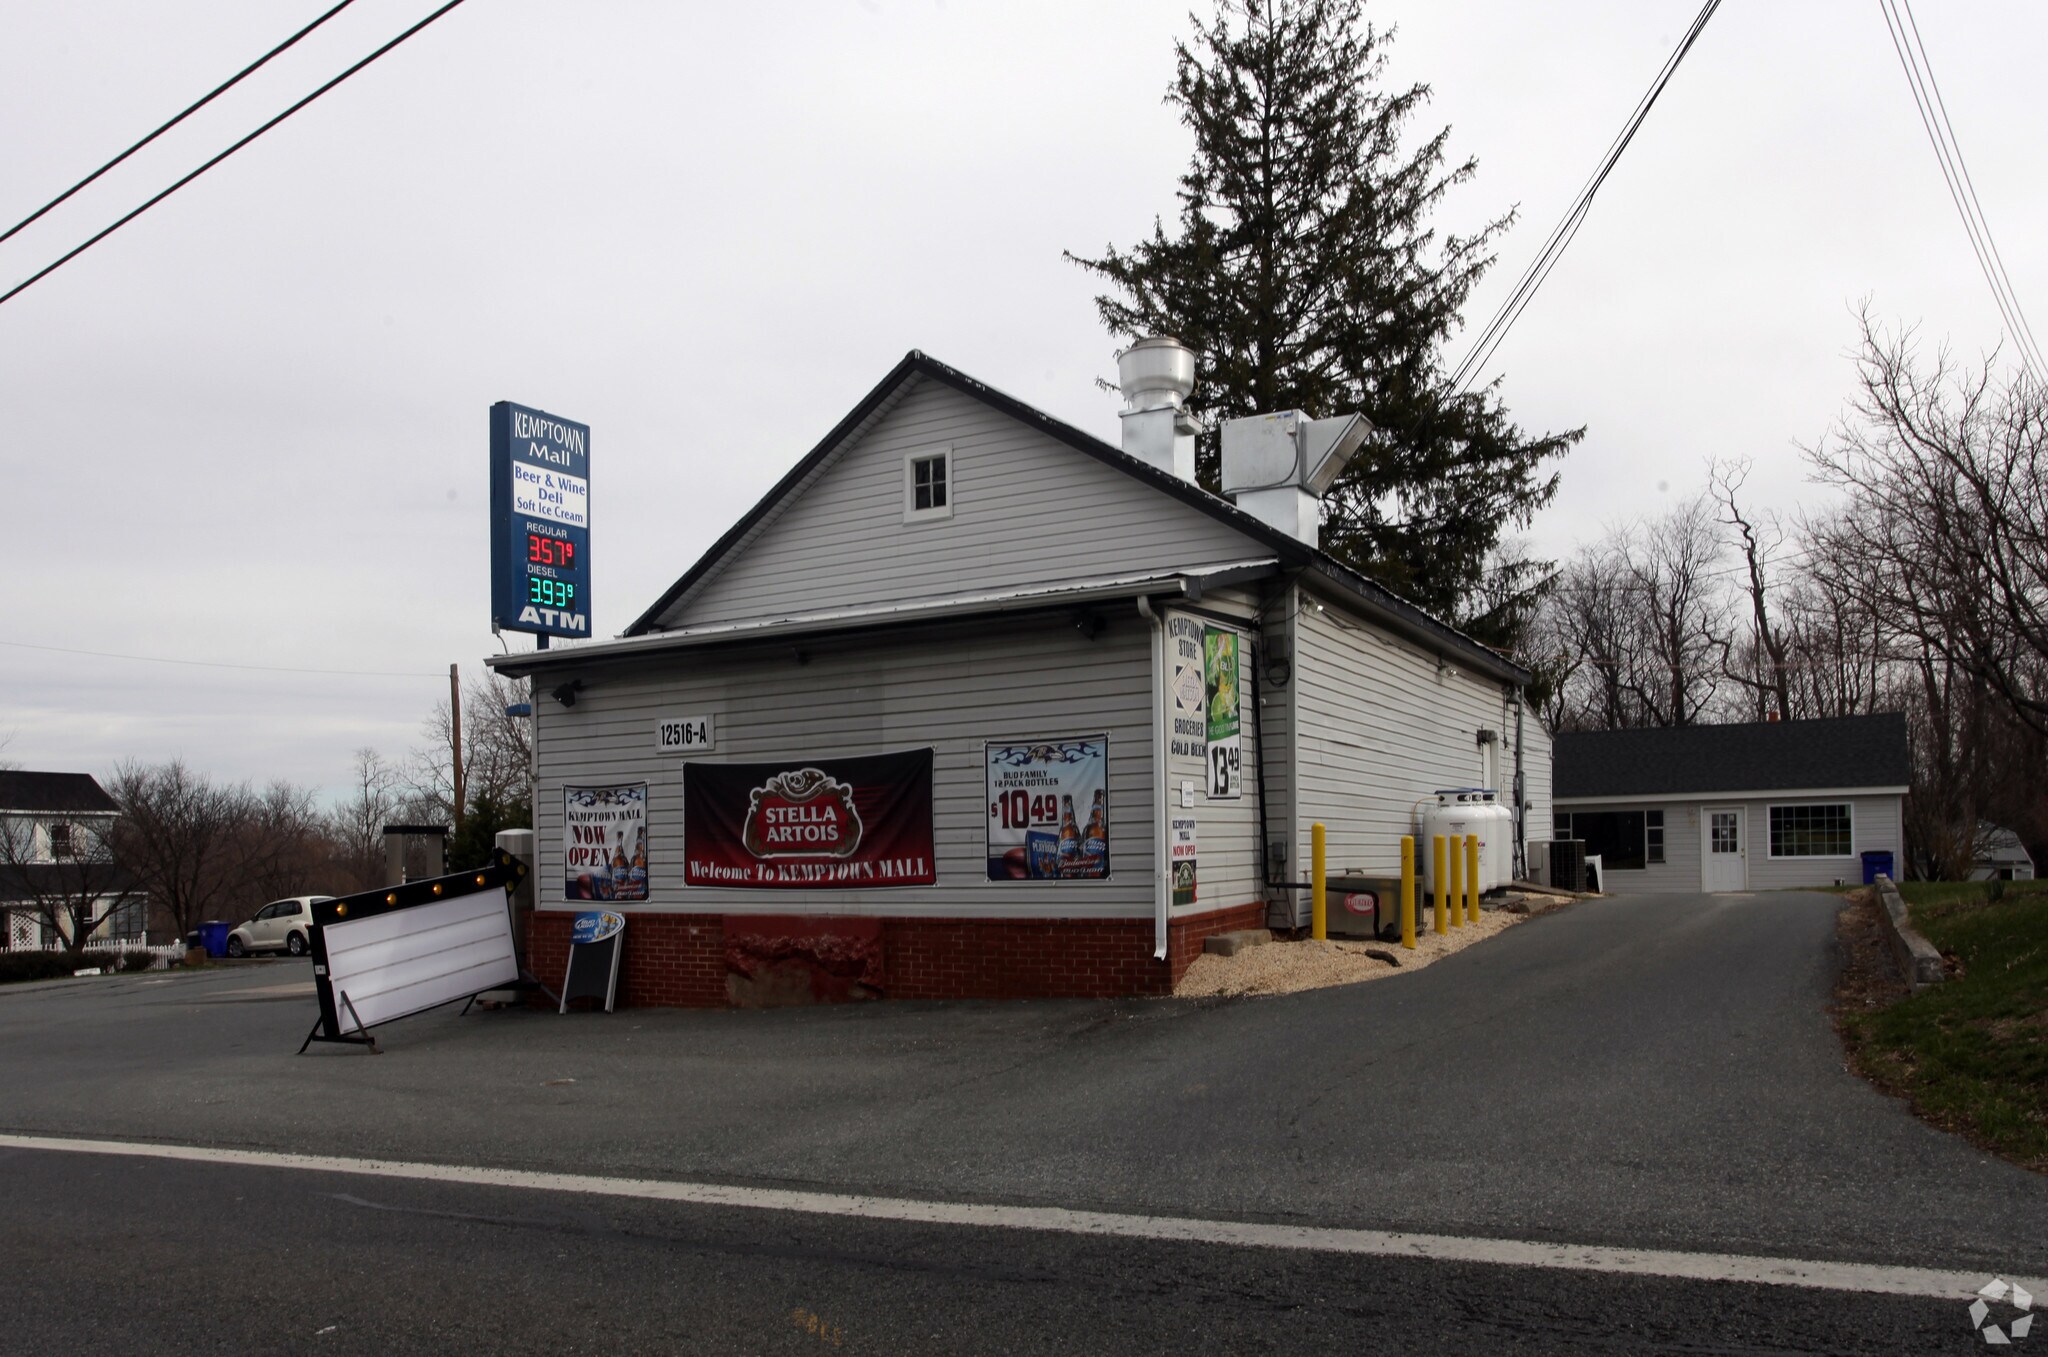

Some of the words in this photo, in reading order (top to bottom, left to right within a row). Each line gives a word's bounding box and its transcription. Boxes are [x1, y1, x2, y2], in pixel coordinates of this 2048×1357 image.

[514, 411, 584, 457] KEMPTOWN
[529, 441, 570, 467] Mall
[515, 465, 541, 485] Beer
[545, 474, 554, 489] &
[558, 476, 586, 496] Wine
[538, 487, 563, 505] Deli
[517, 496, 536, 513] Soft
[538, 502, 552, 516] Ice
[554, 507, 583, 524] Cream
[526, 521, 568, 539] REGULAR
[527, 563, 558, 578] DIESEL
[518, 605, 586, 632] ATM
[1168, 617, 1204, 648] KEMPTOWN
[1178, 638, 1197, 660] STORE
[660, 721, 708, 746] 12516-A
[1174, 718, 1204, 738] GROCERIES
[1171, 739, 1189, 756] COLD
[1191, 742, 1206, 758] BEER
[994, 779, 1003, 788] 12
[1004, 778, 1024, 788] PACK
[1025, 777, 1059, 787] BOTTLES
[1003, 771, 1019, 780] BUD
[1020, 769, 1048, 779] FAMILY
[568, 810, 617, 822] KEMPTOWN
[619, 808, 643, 821] MALL
[765, 805, 837, 823] STELLA
[572, 825, 607, 845] NOW
[766, 824, 839, 842] ARTOIS
[568, 846, 612, 867] OPEN
[1173, 846, 1184, 856] NOW
[1185, 845, 1196, 856] OPEN
[690, 860, 751, 881] Welcome
[755, 863, 774, 881] To
[777, 860, 874, 882] KEMPTOWN
[878, 857, 929, 878] MALL
